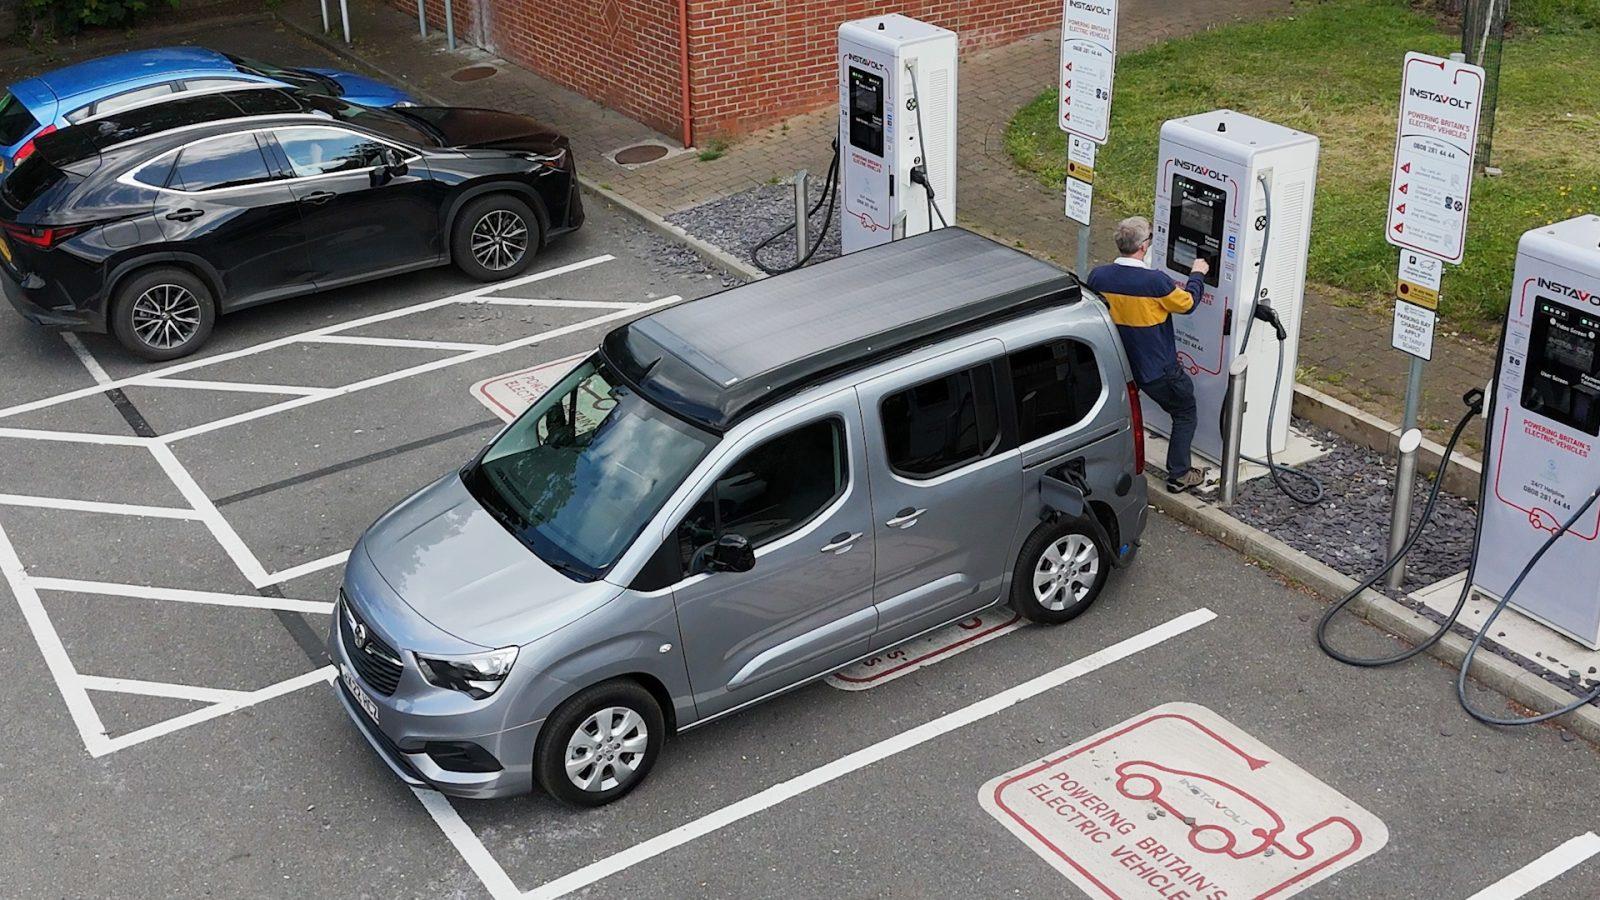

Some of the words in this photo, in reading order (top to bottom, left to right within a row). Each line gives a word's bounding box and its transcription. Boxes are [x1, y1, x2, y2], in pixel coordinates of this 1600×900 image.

[1069, 0, 1112, 15] INSTAVOLT
[848, 52, 884, 71] INSTAVOLT
[1409, 87, 1472, 110] INSTAVOLT
[1407, 110, 1439, 124] POWERING
[1440, 118, 1470, 132] BRITAIN'S
[1408, 118, 1437, 131] ELECTRIC
[1438, 126, 1467, 140] VEHICLES
[1413, 142, 1427, 151] 0808
[1174, 157, 1229, 182] INSTAVOLT
[1556, 322, 1570, 332] Video
[1570, 327, 1587, 338] Screen
[1540, 369, 1552, 379] User
[1552, 374, 1568, 385] Screen
[1523, 419, 1558, 438] POWERING
[1558, 433, 1591, 451] BRITAIN'S
[1524, 427, 1556, 444] ELECTRIC
[1555, 440, 1588, 458] VEHICLES
[1523, 485, 1539, 497] 0808
[1553, 498, 1561, 506] 44
[1562, 502, 1571, 510] 44
[1027, 783, 1111, 843] ELECTRIC
[1049, 772, 1136, 836] POWERING
[1135, 836, 1228, 900] BRITAIN'S
